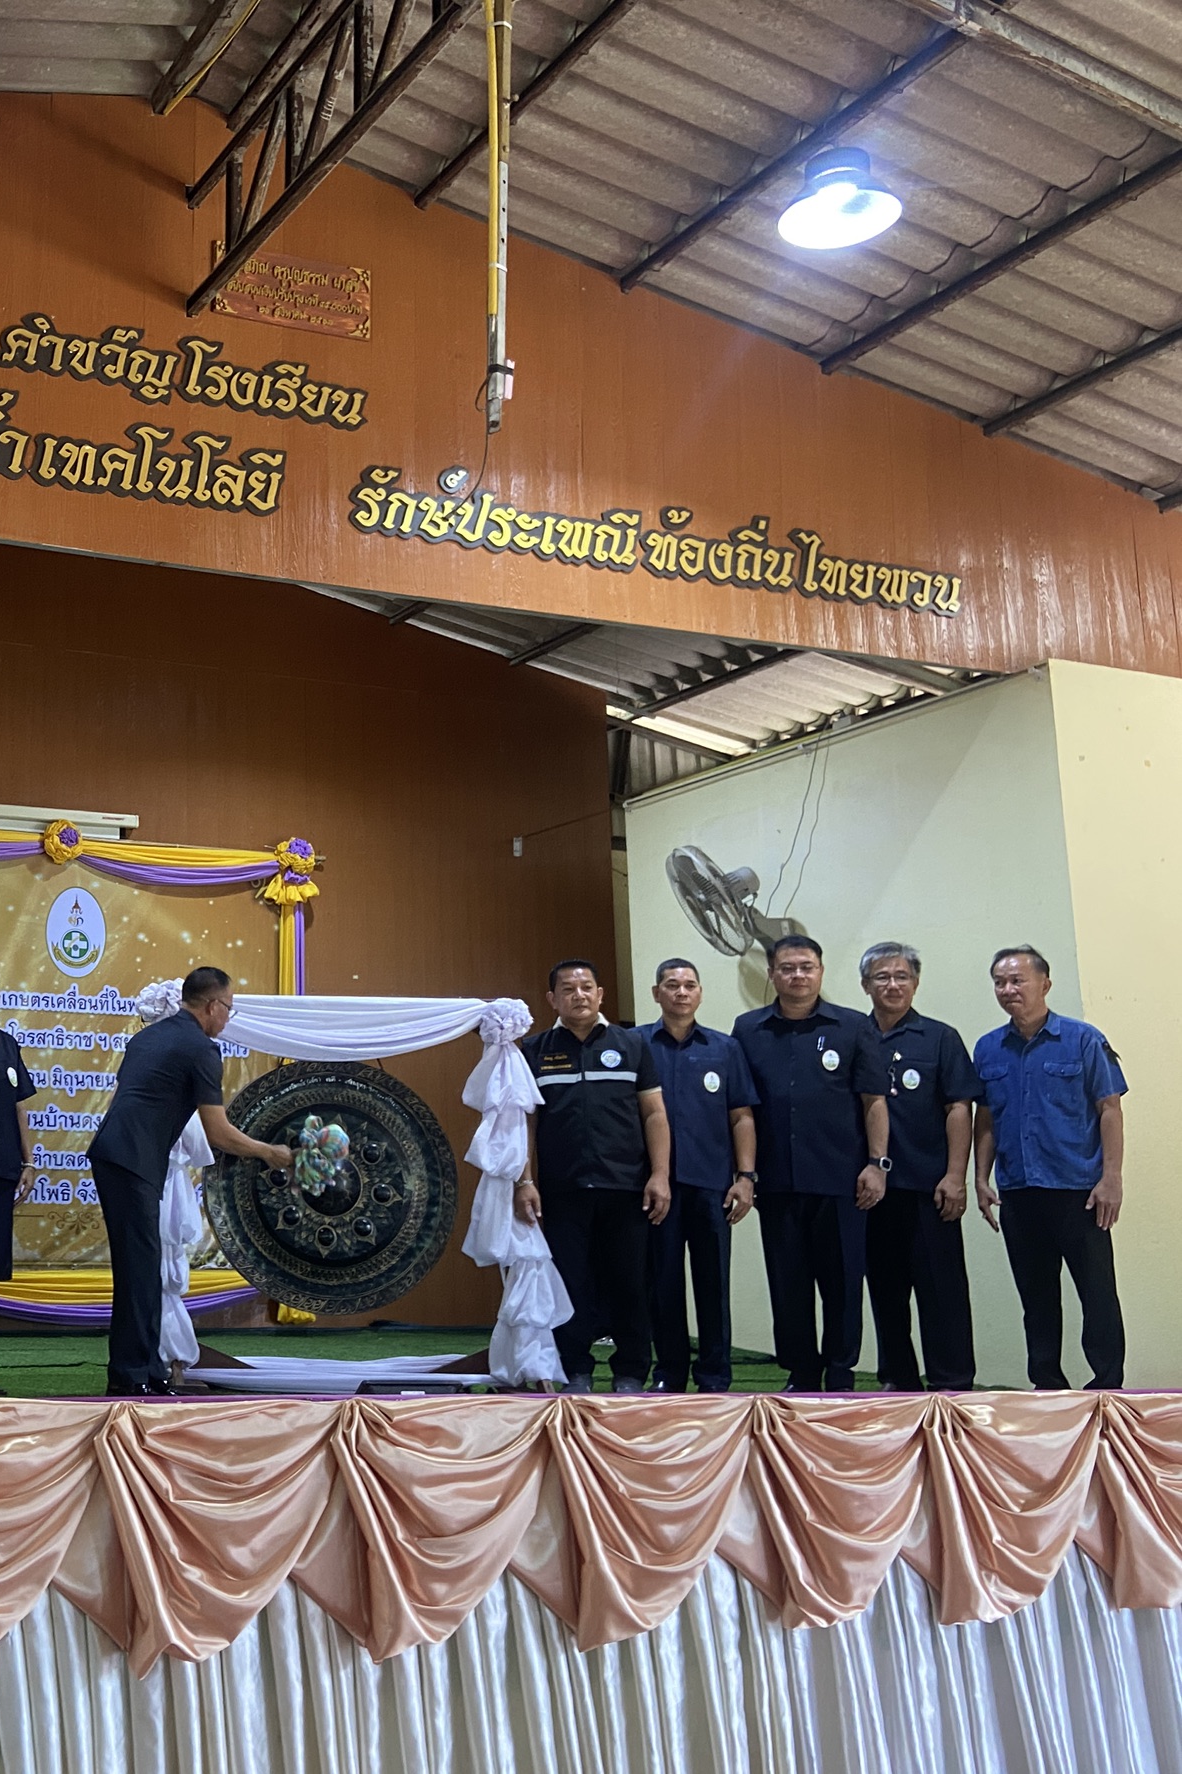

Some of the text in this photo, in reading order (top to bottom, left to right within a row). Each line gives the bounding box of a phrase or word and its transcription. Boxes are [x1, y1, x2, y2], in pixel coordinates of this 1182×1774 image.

[2, 317, 364, 426] คำขวัญ โรงเรียน
[38, 426, 284, 511] เทคโนโลยี
[645, 509, 795, 588] ท้องถิ่น
[798, 531, 962, 612] ไทยพวน
[27, 1106, 102, 1130] นบ้านดง
